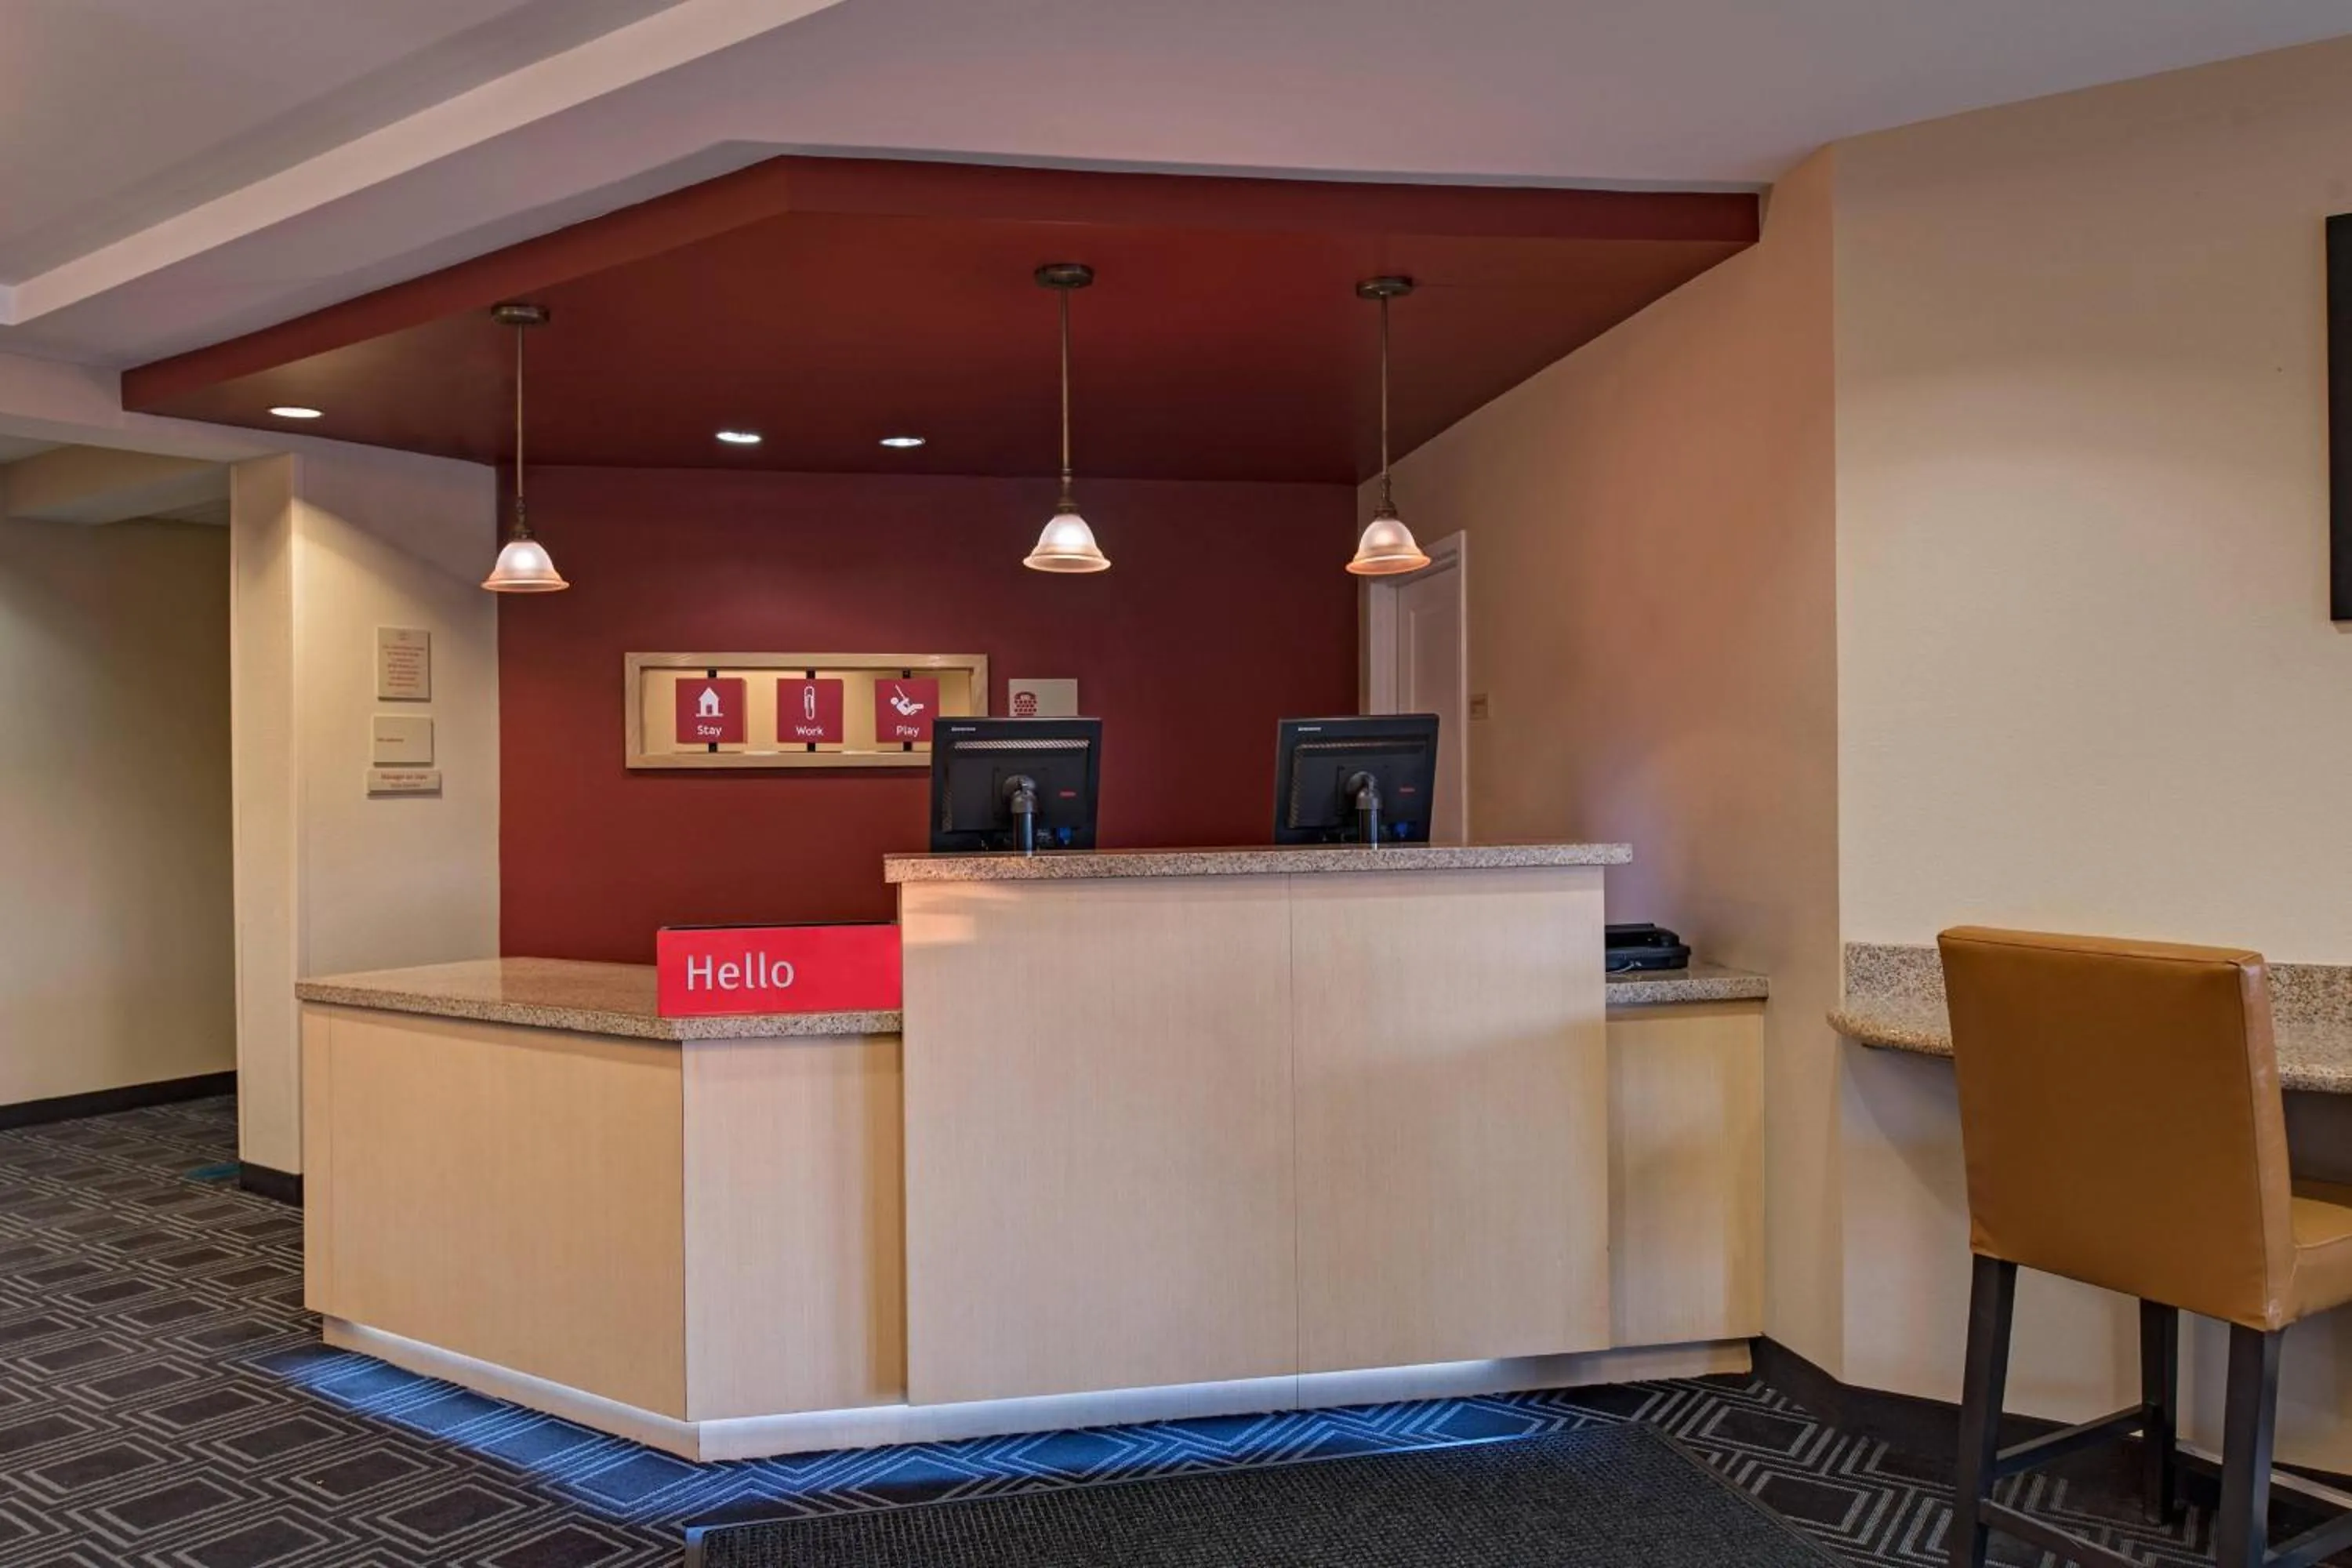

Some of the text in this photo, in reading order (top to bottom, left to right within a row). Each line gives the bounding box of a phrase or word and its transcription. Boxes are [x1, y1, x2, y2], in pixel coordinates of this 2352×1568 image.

[696, 723, 723, 738] Stay
[795, 724, 824, 737] Work
[895, 724, 920, 739] Play
[687, 951, 795, 991] Hello
